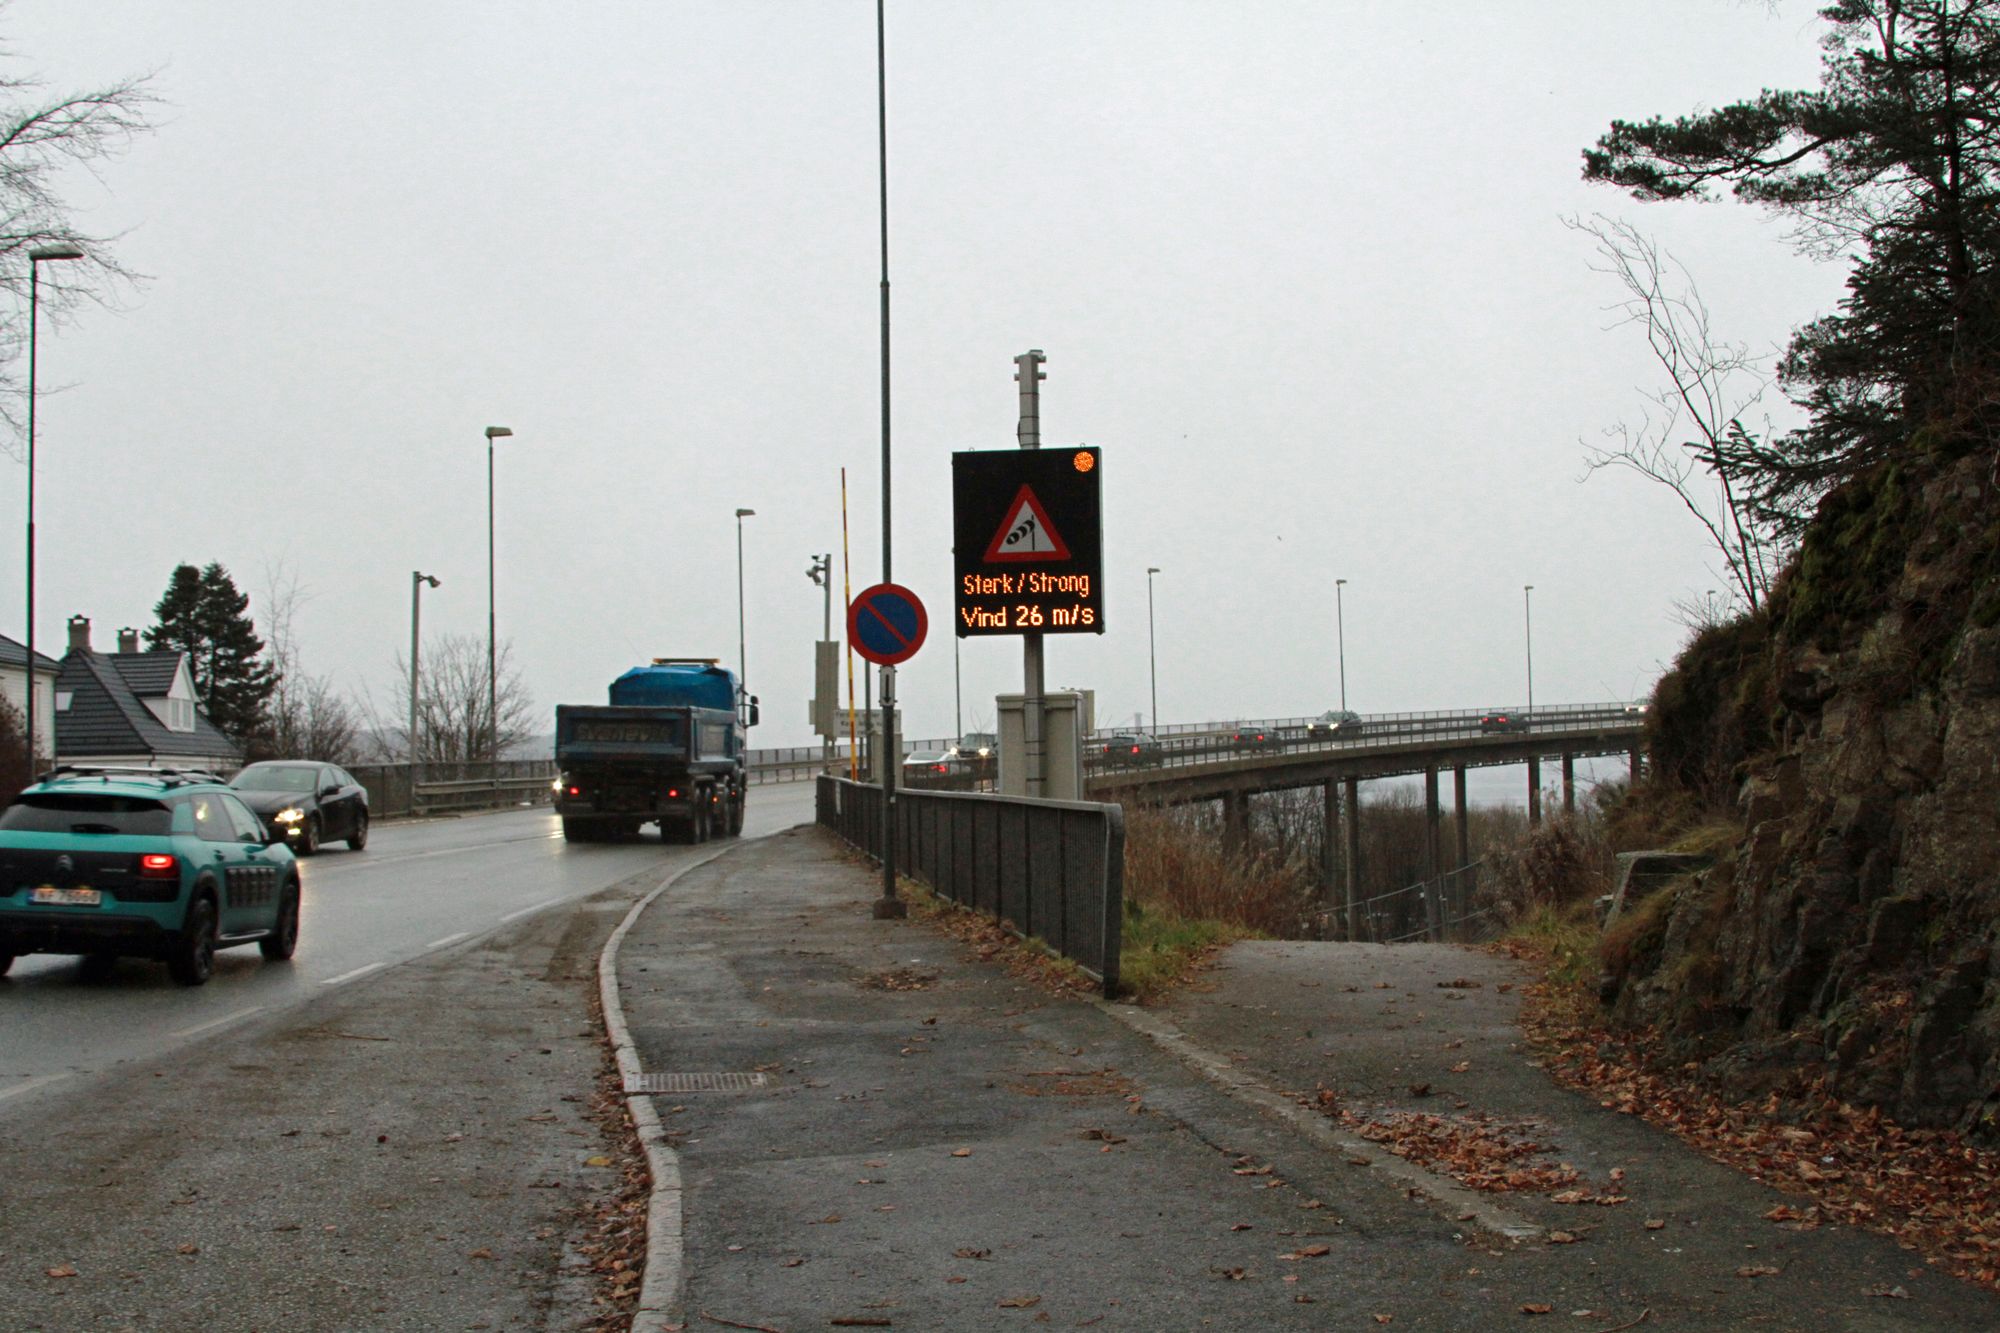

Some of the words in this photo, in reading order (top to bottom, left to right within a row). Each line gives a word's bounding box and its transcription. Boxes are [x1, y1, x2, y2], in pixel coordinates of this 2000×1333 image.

[963, 574, 1014, 595] Sterk
[1029, 572, 1090, 598] Strong
[961, 606, 1007, 628] Vind
[1015, 605, 1044, 627] 26
[1052, 604, 1095, 626] m/s
